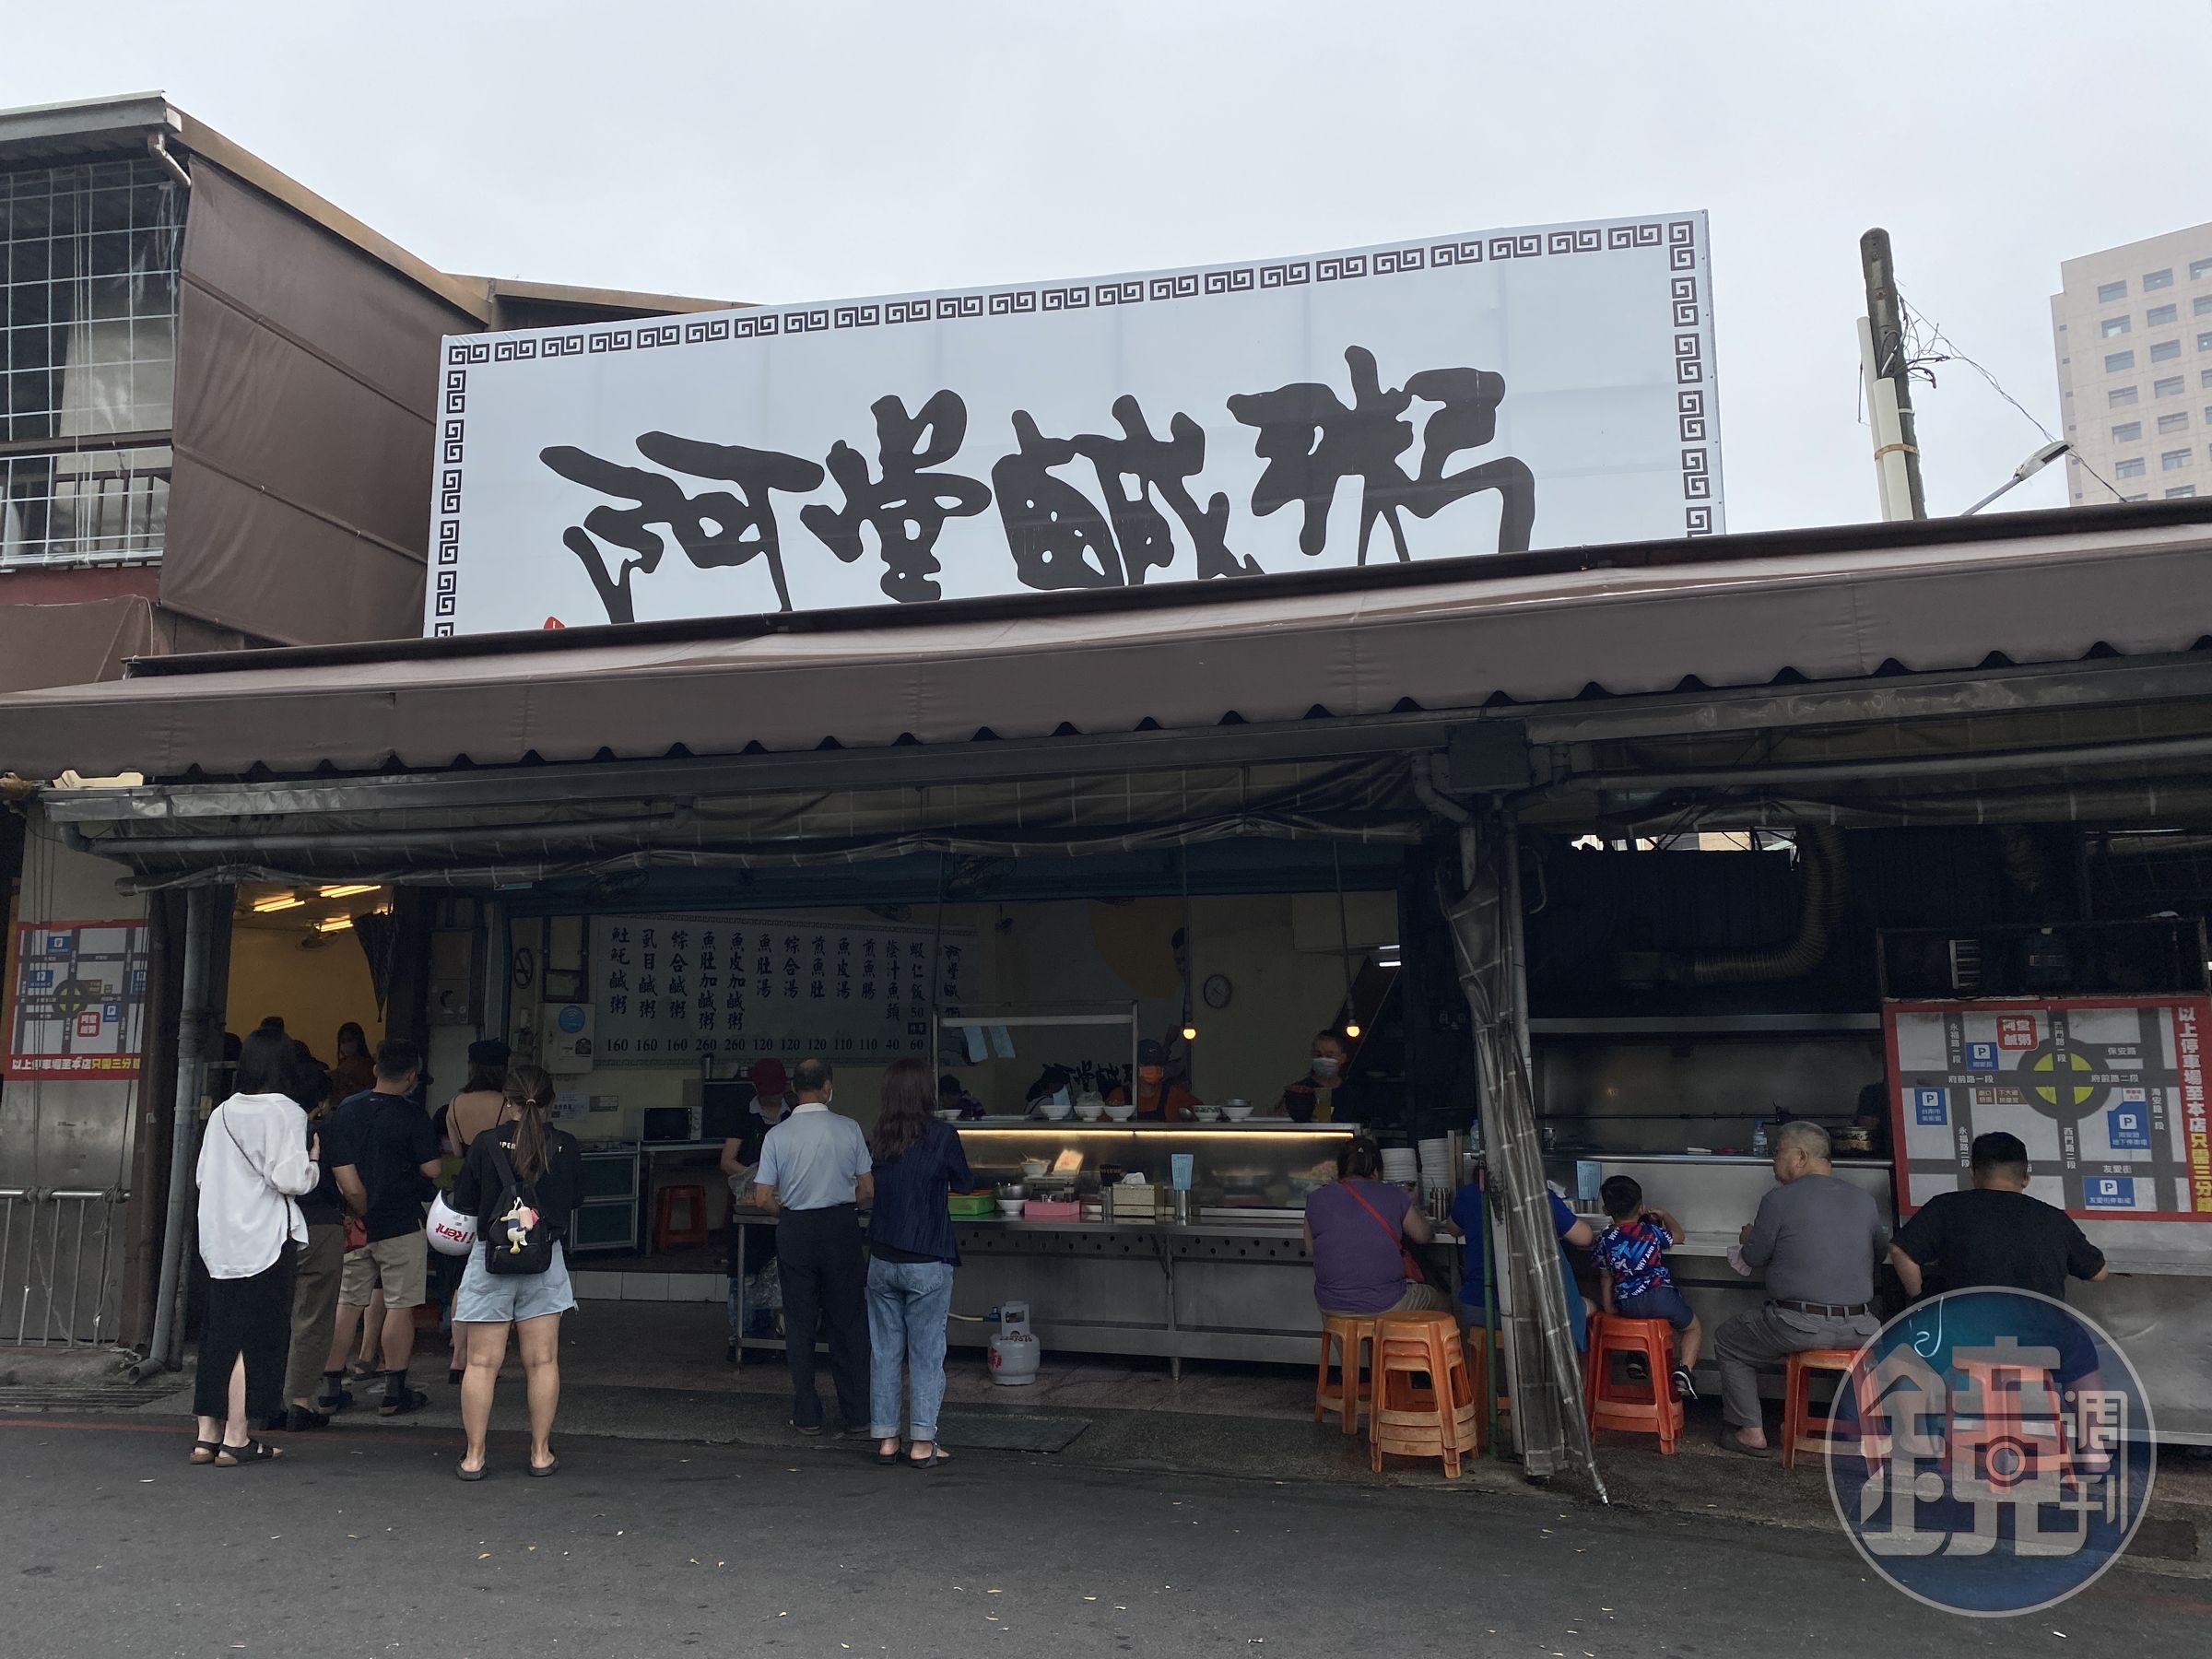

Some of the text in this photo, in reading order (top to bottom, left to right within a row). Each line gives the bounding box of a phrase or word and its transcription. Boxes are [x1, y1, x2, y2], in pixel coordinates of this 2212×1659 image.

[756, 934, 772, 998] 魚肚湯
[782, 935, 801, 999] 綜合湯
[810, 936, 826, 998] 煎魚肚
[836, 937, 852, 999] 魚皮湯
[862, 939, 877, 1000] 煎魚腸
[909, 943, 925, 1001] 蝦仁飯
[639, 929, 657, 1018] 虱目鹹粥
[669, 931, 688, 1018] 綜合鹹粥
[698, 931, 717, 1030] 魚肚加鹹粥
[726, 933, 746, 1030] 魚皮加鹹粥
[911, 1006, 924, 1018] 50
[607, 1039, 629, 1051] 160
[637, 1039, 657, 1051] 160
[667, 1039, 688, 1051] 160
[696, 1039, 717, 1051] 260
[724, 1039, 745, 1051] 260
[754, 1039, 772, 1051] 120
[781, 1039, 800, 1051] 120
[808, 1039, 827, 1051] 120
[834, 1039, 853, 1051] 110
[860, 1039, 877, 1051] 110
[886, 1039, 900, 1051] 40
[910, 1039, 924, 1051] 60
[1949, 1023, 1961, 1064] 永福路一段
[2108, 1047, 2136, 1055] 保安路
[1948, 1075, 1994, 1084] 府前路一段
[2091, 1074, 2139, 1083] 府前路二段
[2064, 1127, 2076, 1169] 西門路二段
[2102, 1165, 2132, 1174] 友愛街
[435, 1223, 476, 1243] iRent
